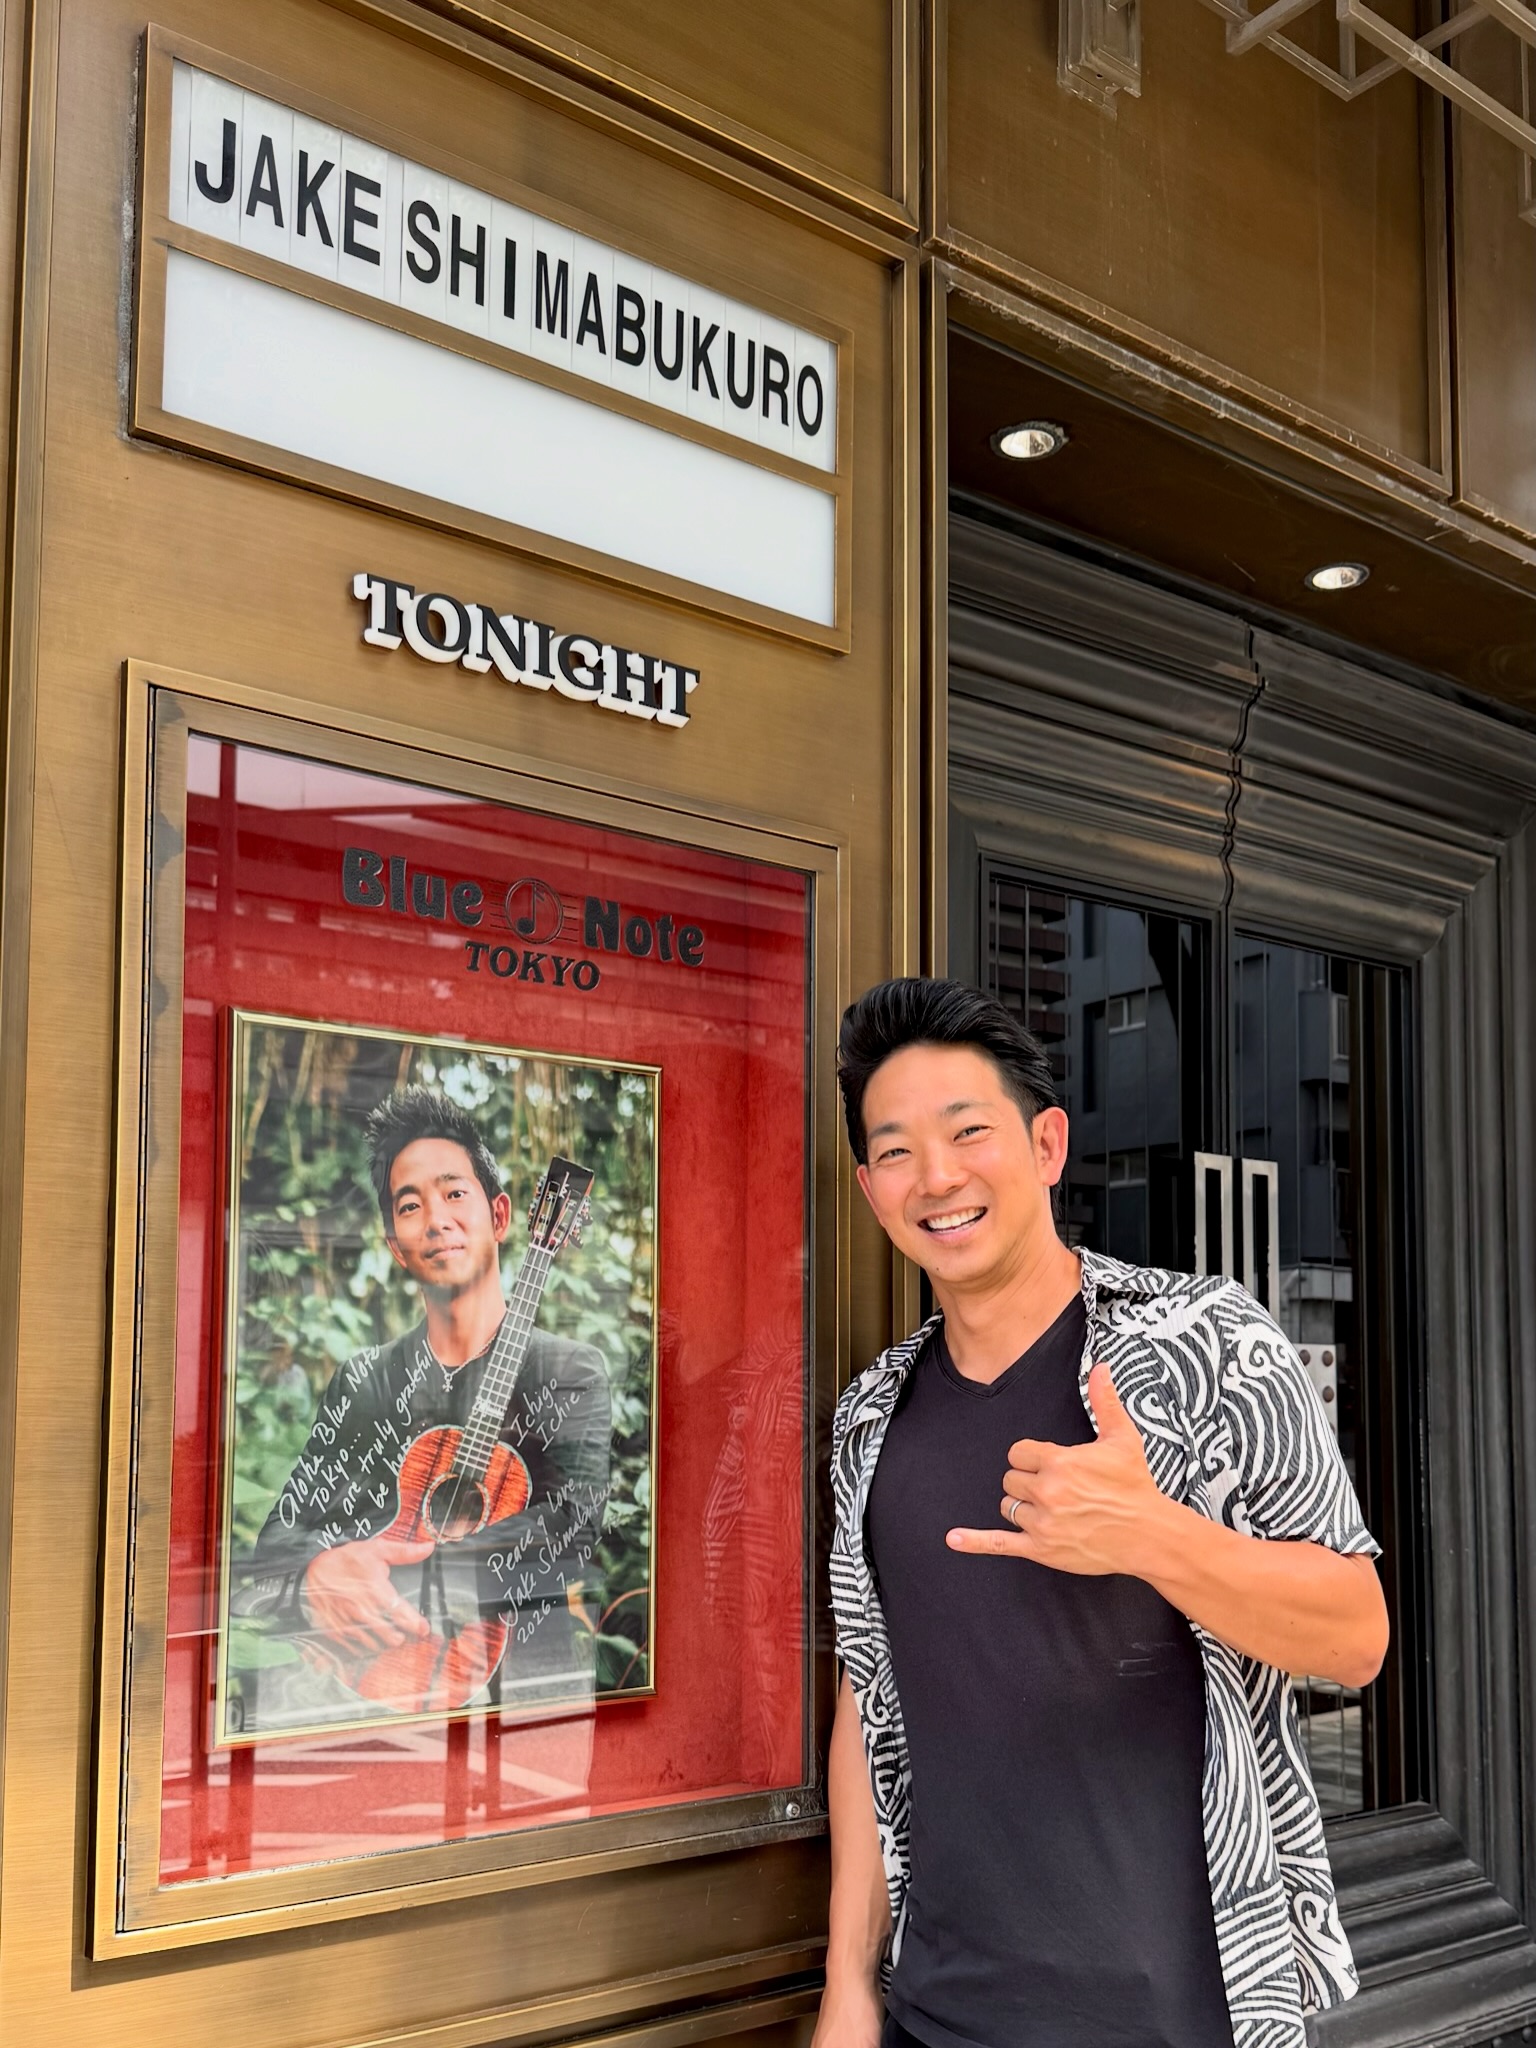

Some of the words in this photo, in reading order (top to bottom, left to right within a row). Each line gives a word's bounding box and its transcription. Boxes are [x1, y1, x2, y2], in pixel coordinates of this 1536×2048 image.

[194, 118, 382, 266] JAKE
[405, 200, 824, 437] SHIMABUKURO
[352, 573, 700, 728] TONIGHT
[342, 846, 485, 927] Blue
[584, 896, 705, 967] Note
[464, 940, 600, 991] TOKYO
[312, 1395, 352, 1446] Blue
[346, 1344, 380, 1393] Note
[510, 1378, 557, 1447] Ichigo
[317, 1521, 342, 1550] We
[343, 1481, 362, 1516] are
[358, 1418, 400, 1474] truly
[396, 1339, 433, 1427] grateful
[355, 1517, 372, 1538] to
[368, 1482, 389, 1509] be
[487, 1529, 534, 1582] Peace
[498, 1571, 537, 1627] Jake
